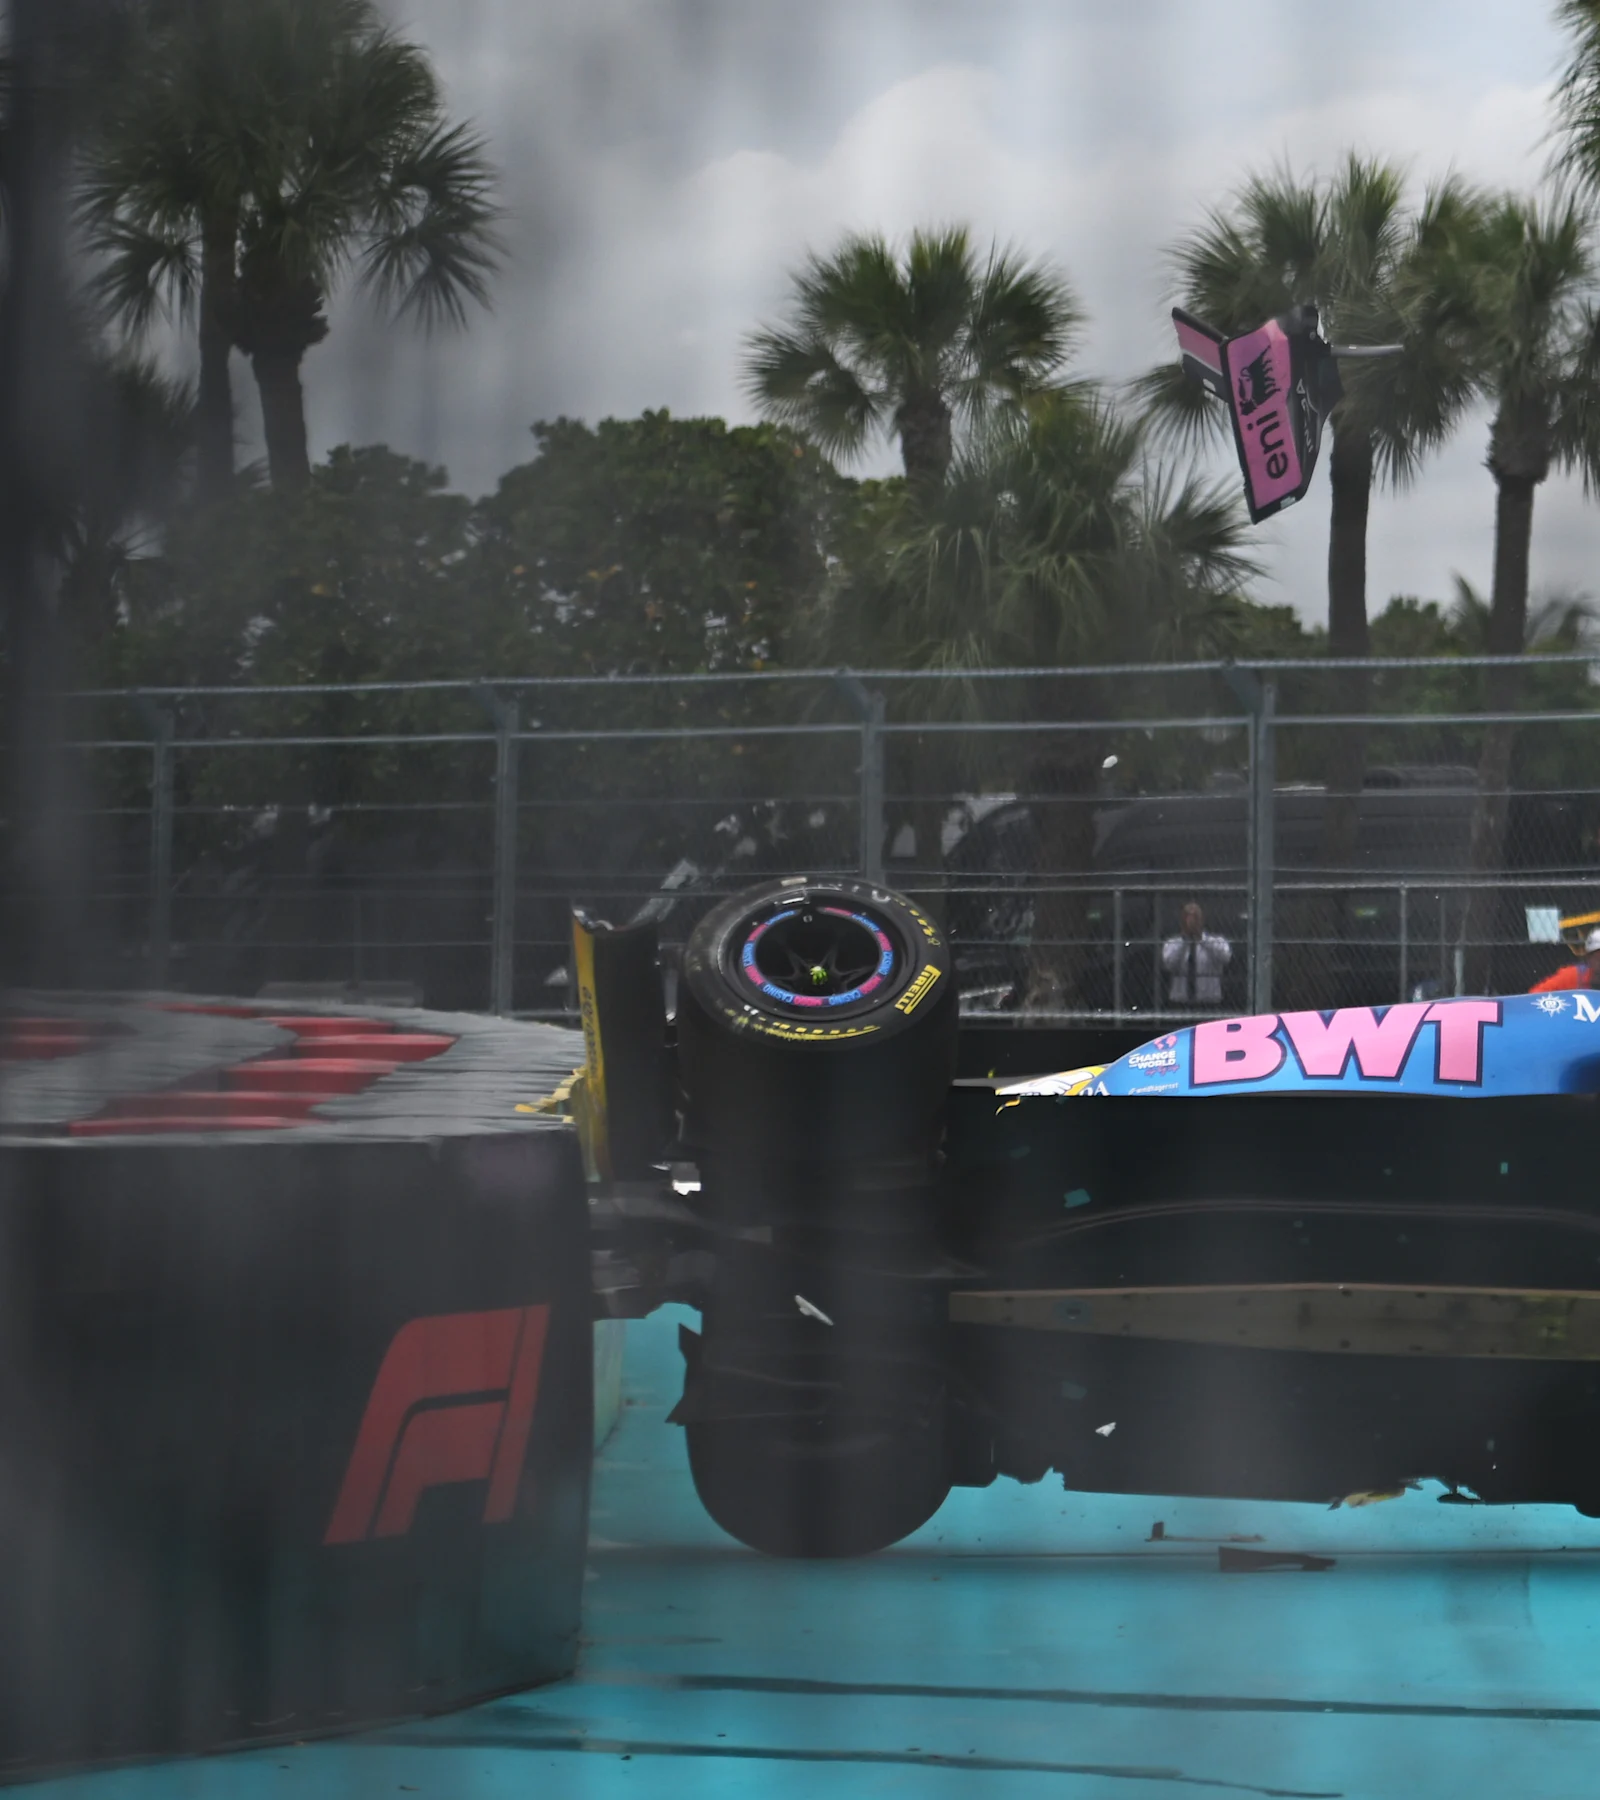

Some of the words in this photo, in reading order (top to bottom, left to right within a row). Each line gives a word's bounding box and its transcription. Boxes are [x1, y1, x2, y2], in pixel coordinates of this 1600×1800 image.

[1247, 409, 1289, 480] eni
[762, 984, 794, 1004] CASINO
[894, 965, 942, 1015] PIRELLI
[1128, 1050, 1177, 1065] CHANGE
[1138, 1058, 1177, 1070] WORLD
[1190, 1000, 1504, 1089] BWT
[322, 1303, 552, 1545] F1
